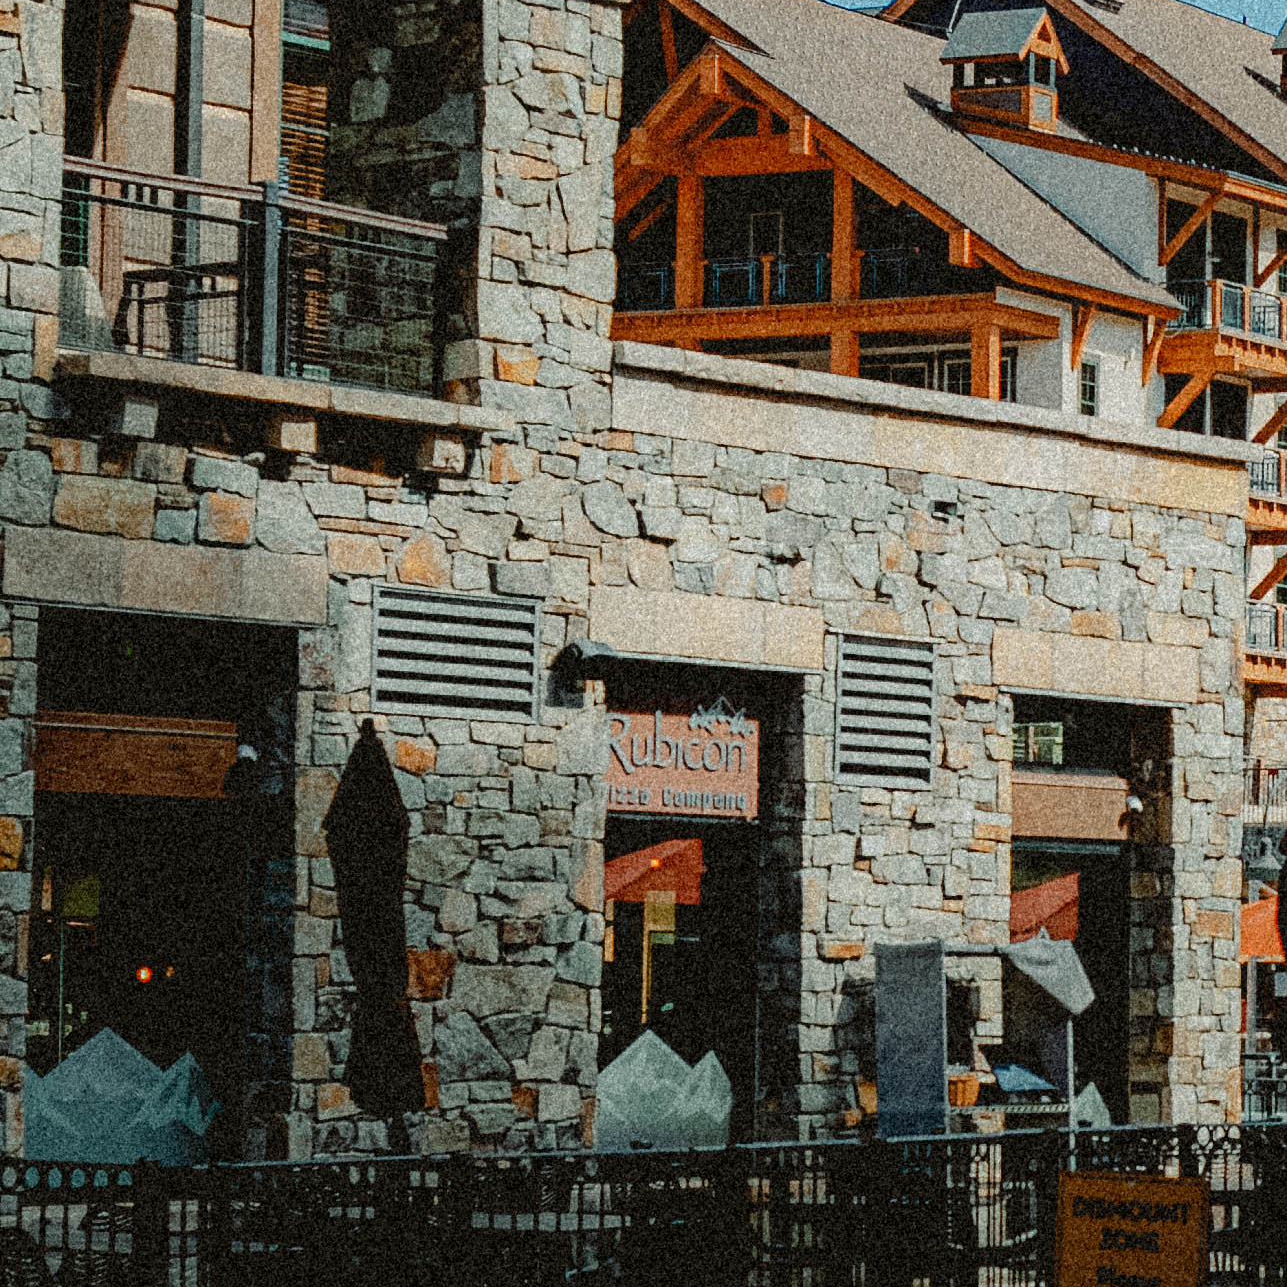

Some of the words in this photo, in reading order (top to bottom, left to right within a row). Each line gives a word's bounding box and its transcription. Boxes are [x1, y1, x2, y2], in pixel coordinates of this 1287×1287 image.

[607, 711, 747, 774] Rubicon
[609, 785, 651, 805] izza
[663, 786, 747, 811] Company
[1072, 1196, 1192, 1224] DISMOUNT
[1100, 1227, 1160, 1252] ZONE
